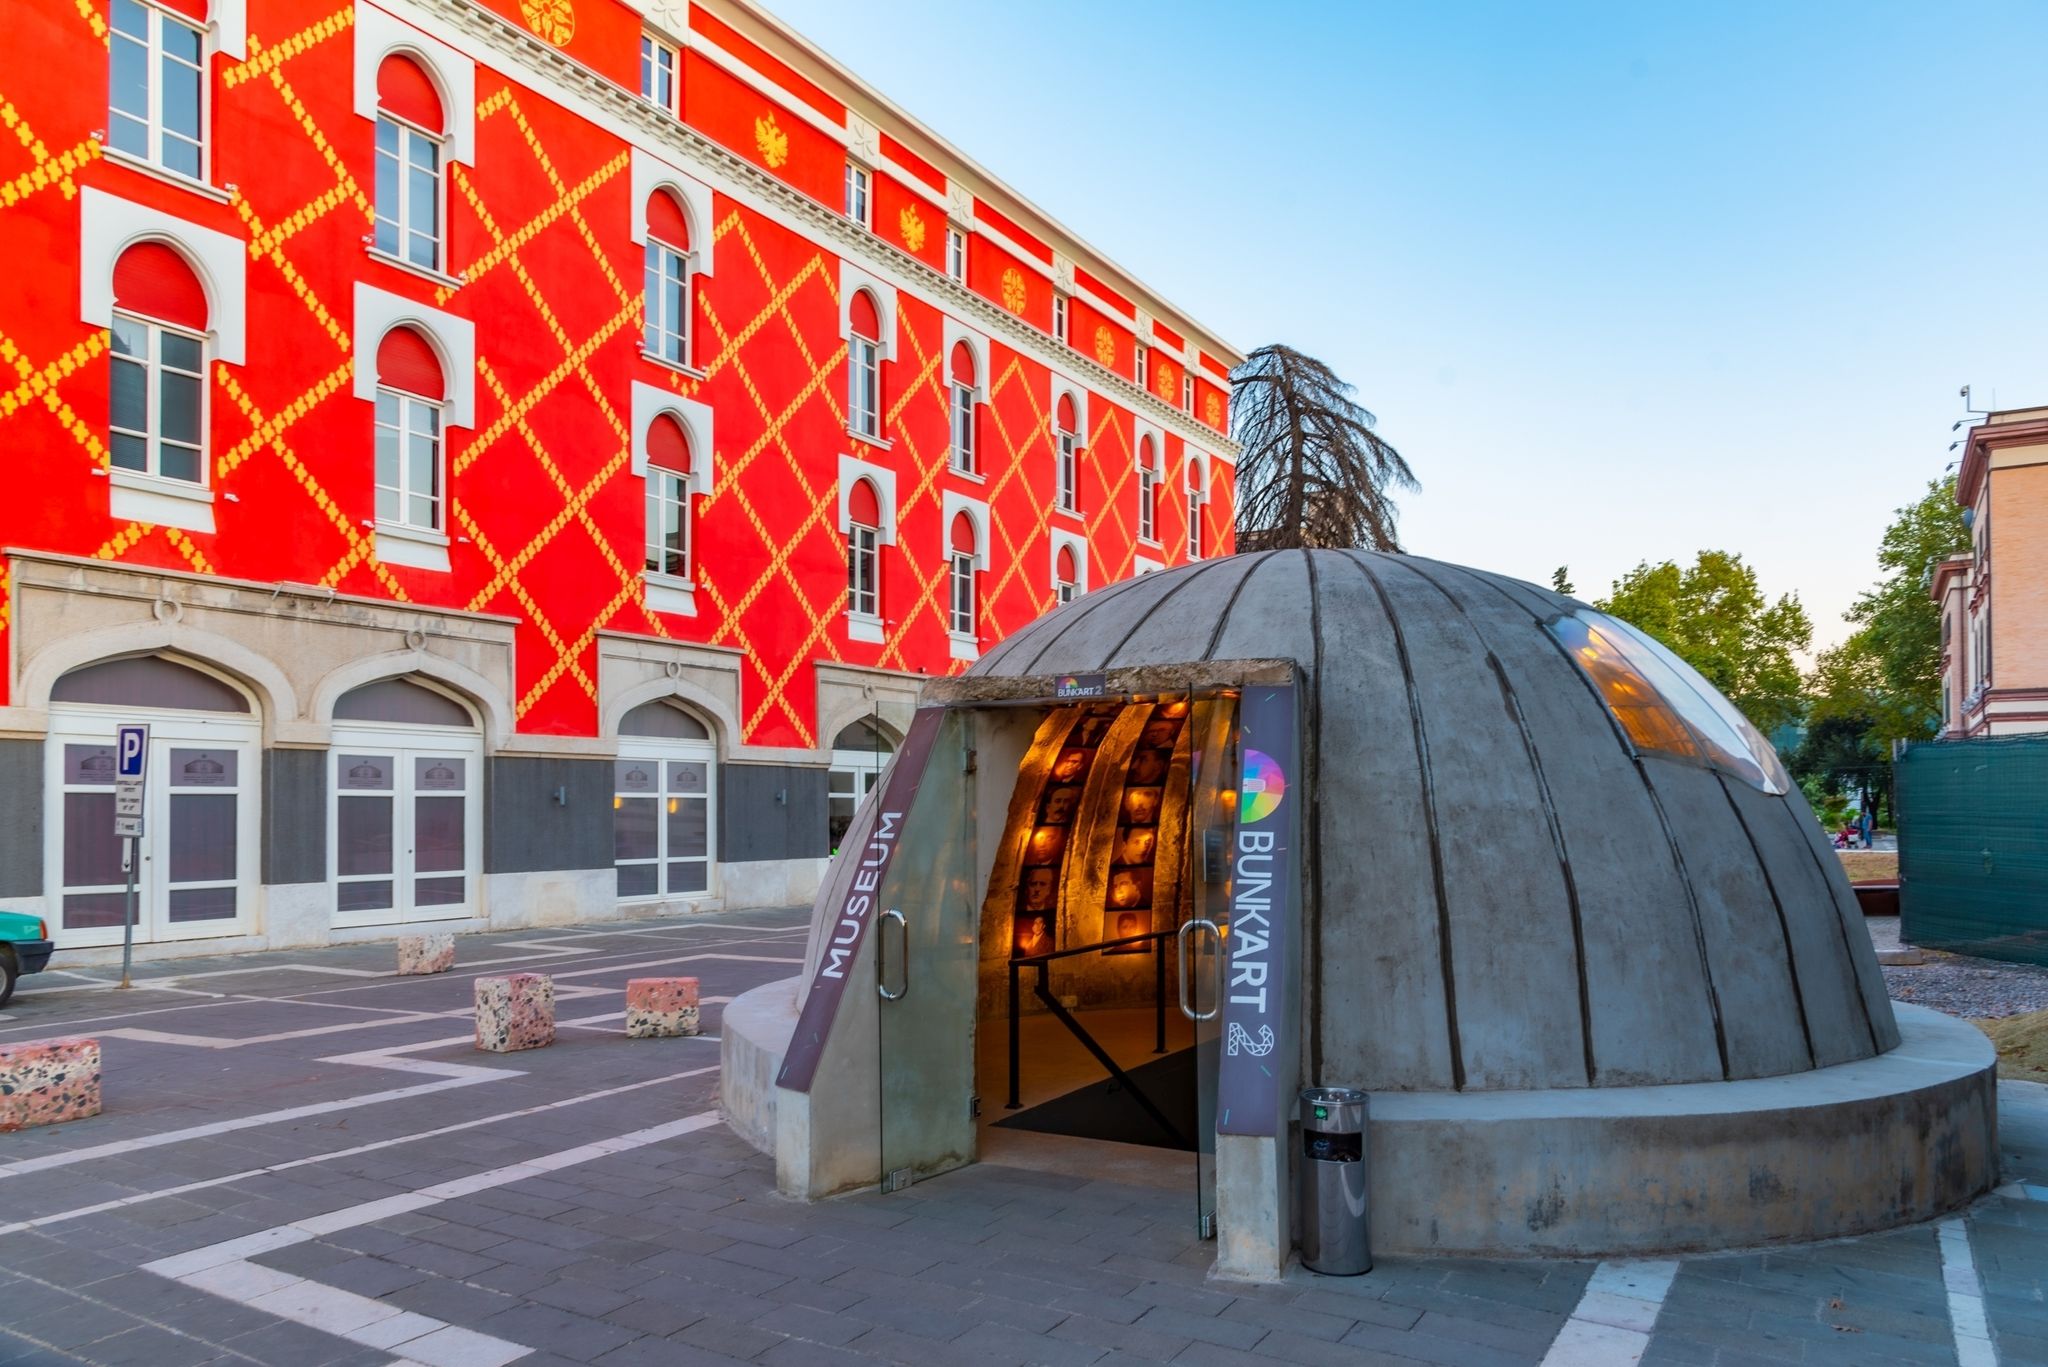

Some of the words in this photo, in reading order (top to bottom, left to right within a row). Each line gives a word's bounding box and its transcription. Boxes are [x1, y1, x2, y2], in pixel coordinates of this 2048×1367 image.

[1095, 685, 1103, 696] 2
[123, 732, 140, 771] P
[822, 812, 903, 979] MUSEUM
[1230, 831, 1274, 1014] BUNK'ART
[1227, 1022, 1275, 1057] 2
